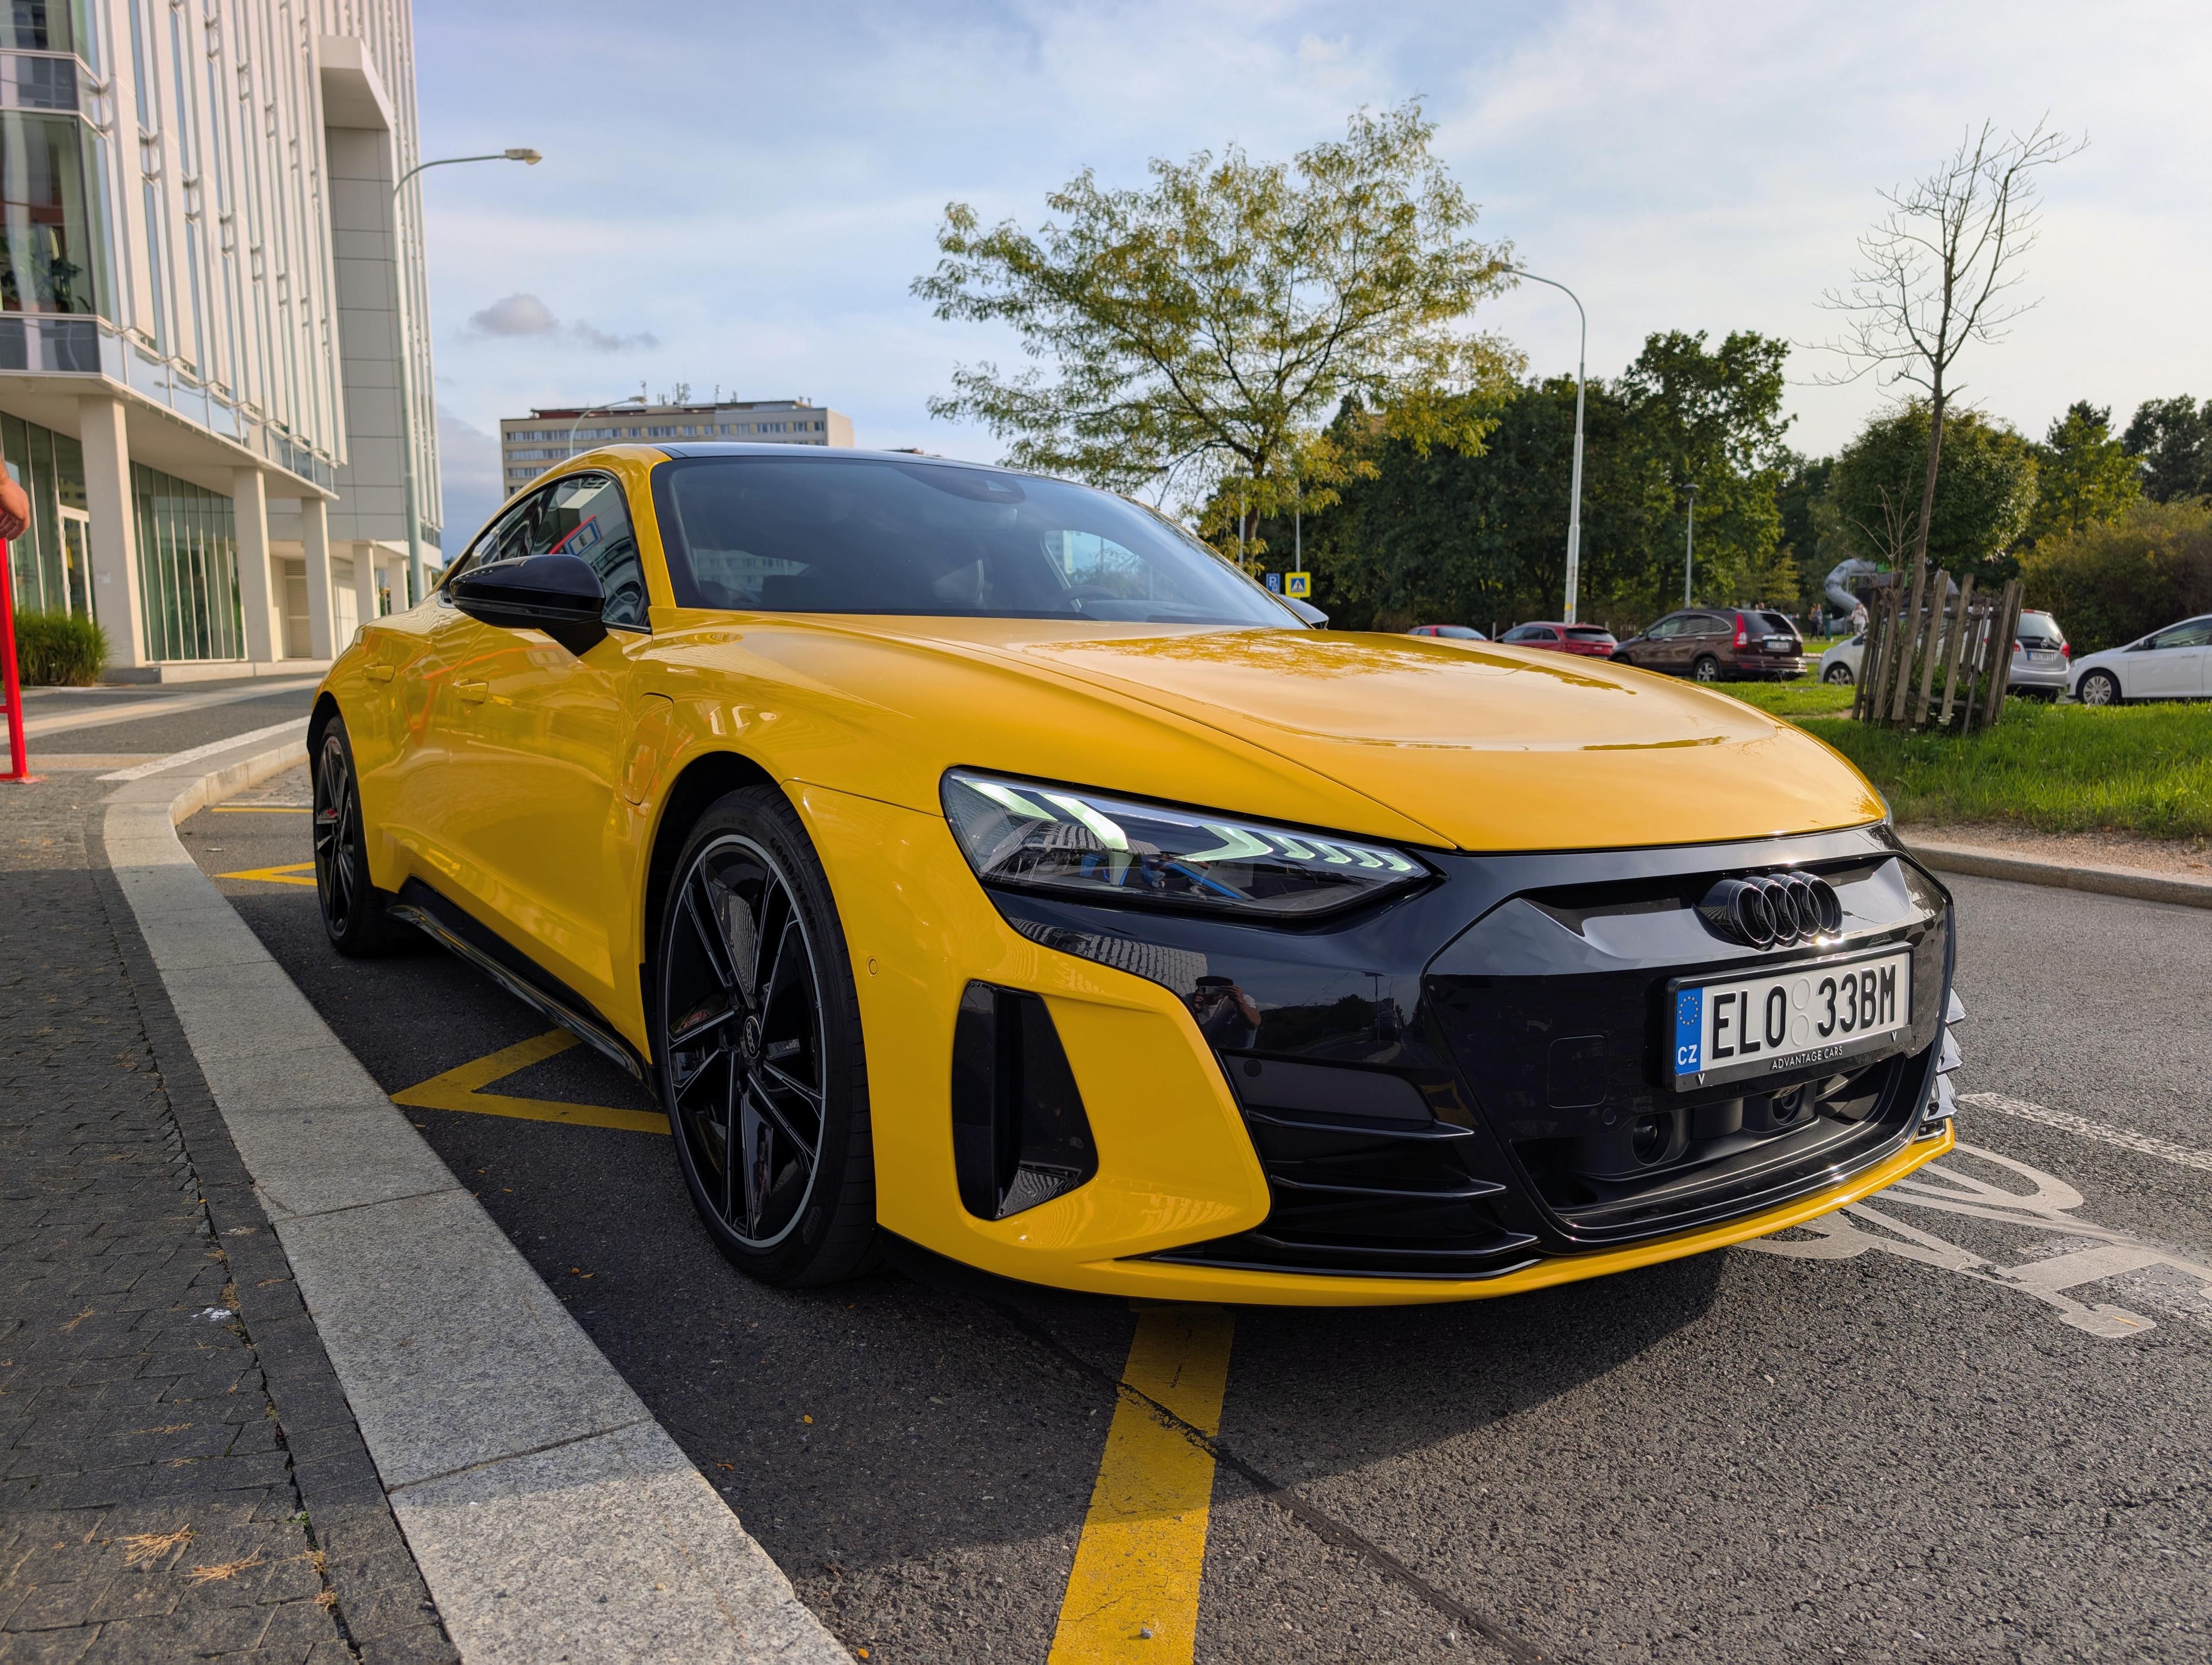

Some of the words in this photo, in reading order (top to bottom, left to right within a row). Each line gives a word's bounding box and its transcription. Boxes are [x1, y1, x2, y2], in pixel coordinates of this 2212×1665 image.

[1269, 576, 1277, 587] P
[770, 836, 817, 932] GOODYEAR
[1817, 963, 1896, 1038] 33BM
[1677, 1044, 1697, 1065] CZ
[1772, 1050, 1822, 1070] ADVANTAGE
[1824, 1045, 1843, 1059] CARS
